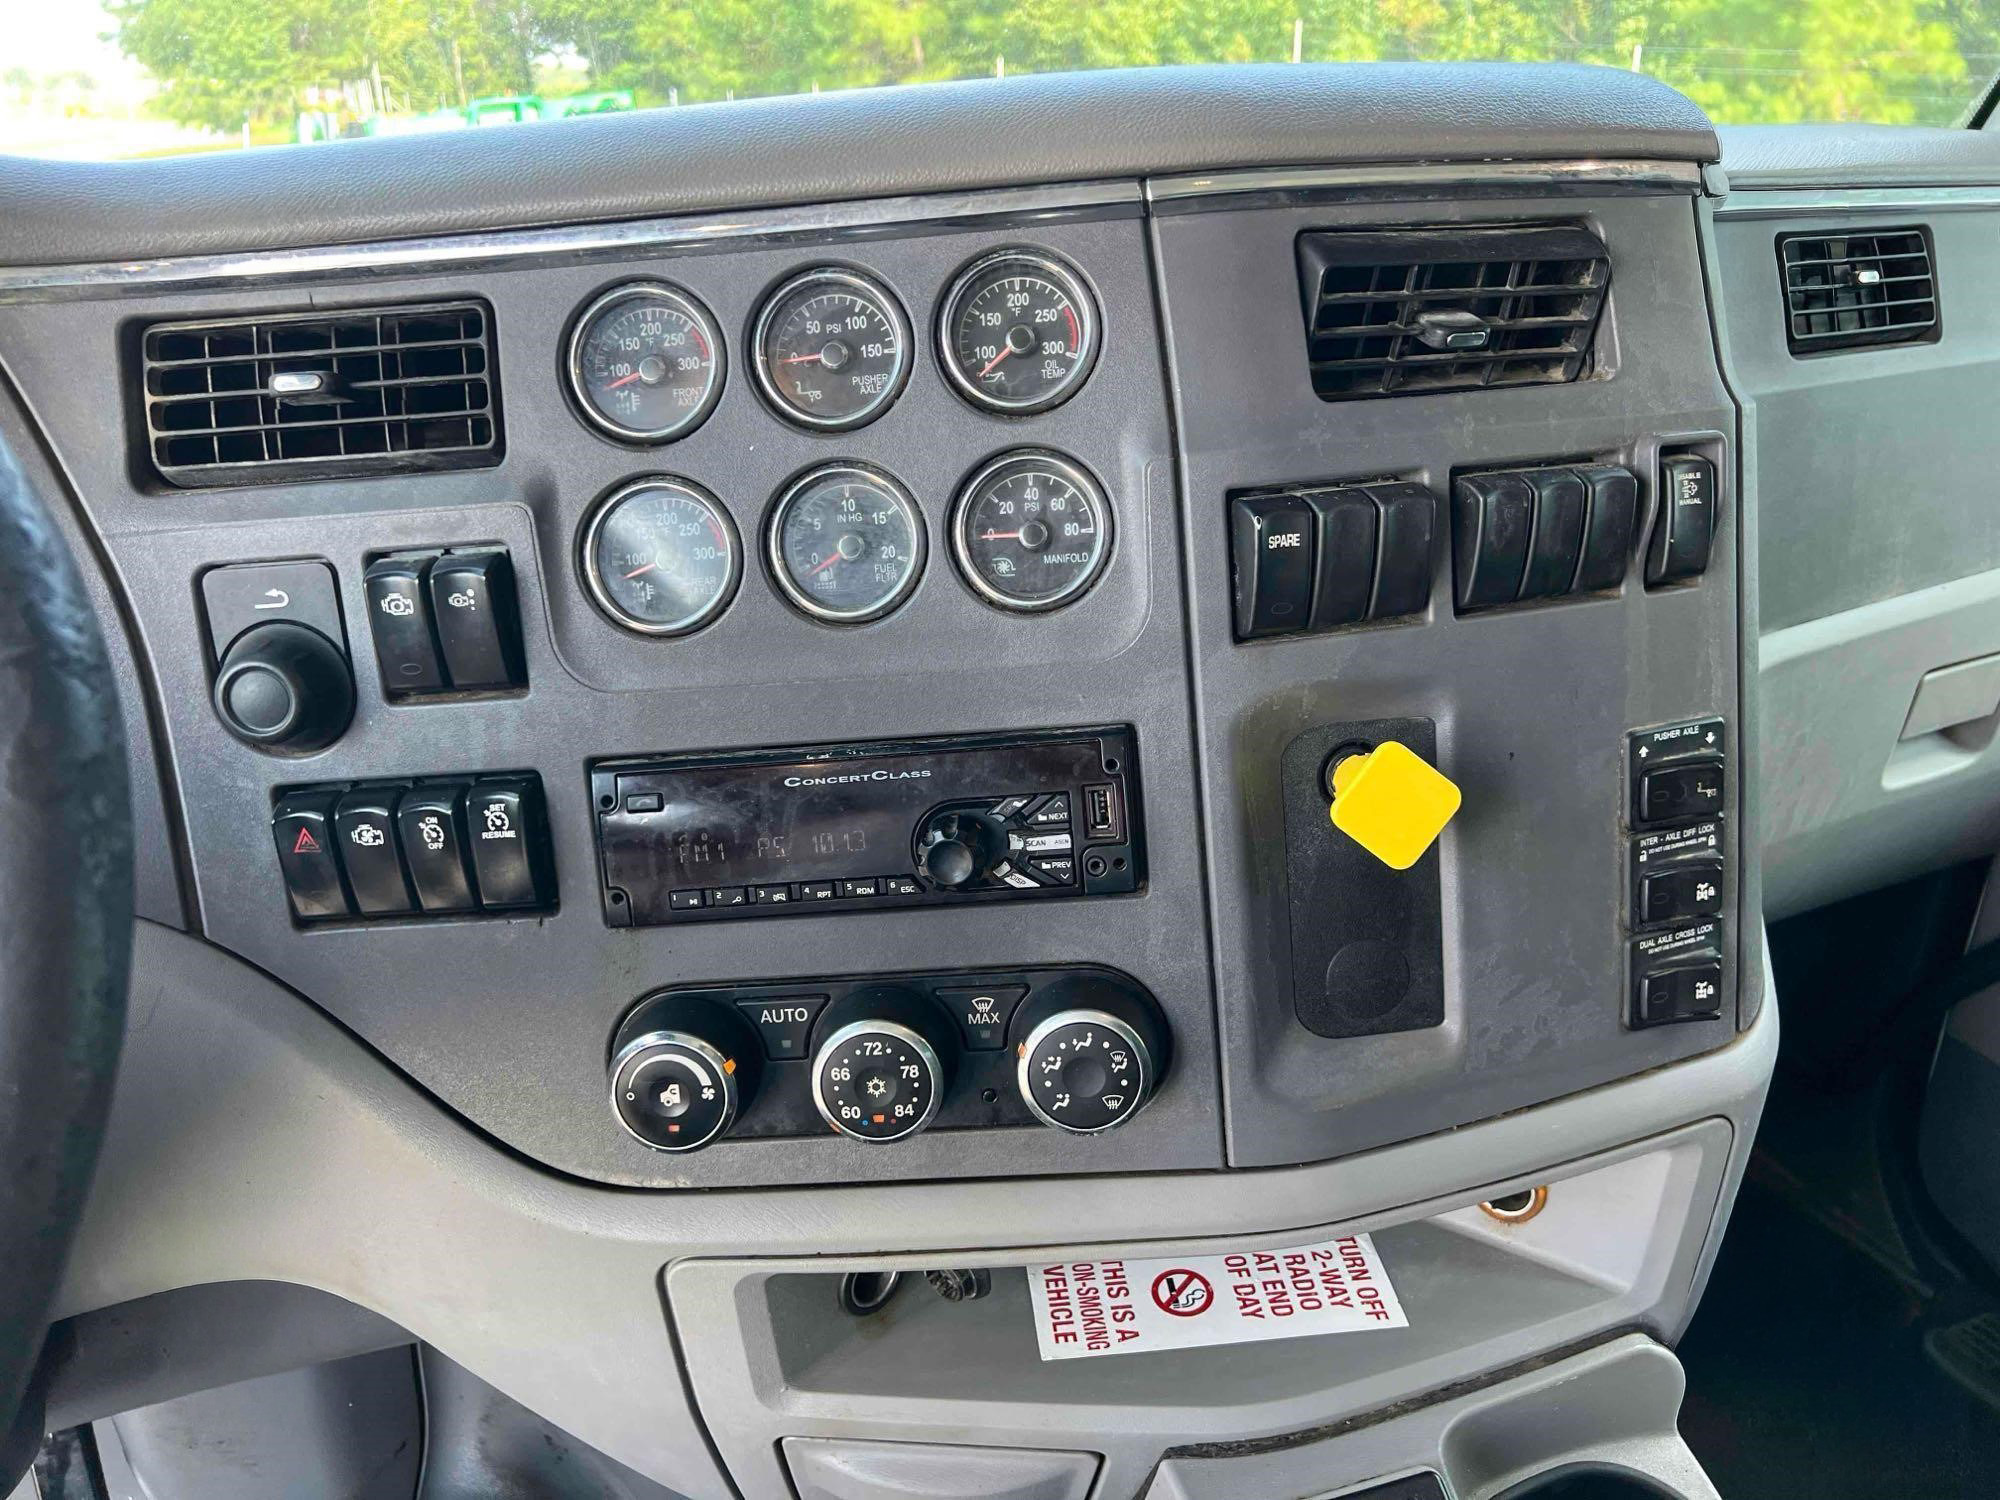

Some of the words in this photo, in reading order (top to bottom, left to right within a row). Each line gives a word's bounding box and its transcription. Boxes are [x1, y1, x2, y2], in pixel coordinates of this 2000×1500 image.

[1007, 293, 1029, 307] 200
[980, 313, 1001, 326] 150
[1035, 309, 1057, 322] 250
[640, 322, 661, 336] 200
[806, 320, 821, 334] 50
[826, 324, 841, 333] PSI
[845, 316, 867, 330] 100
[620, 337, 640, 350] 150
[663, 333, 684, 346] 250
[860, 344, 882, 358] 150
[974, 345, 996, 360] 100
[1042, 341, 1064, 354] 300
[610, 363, 630, 377] 100
[678, 357, 699, 370] 300
[1045, 360, 1058, 369] OIL
[852, 373, 889, 386] PUSHER
[1041, 369, 1066, 379] TEMP
[860, 383, 882, 395] AXLE
[1024, 488, 1038, 500] 40
[841, 499, 855, 512] 10
[999, 502, 1014, 514] 20
[1024, 502, 1040, 512] PSI
[1050, 498, 1065, 510] 60
[656, 513, 678, 526] 200
[814, 519, 821, 530] 5
[837, 514, 847, 523] IN
[849, 513, 863, 522] HG
[872, 512, 887, 525] 15
[679, 523, 700, 536] 250
[1064, 523, 1079, 536] 80
[1268, 533, 1300, 549] SPARE
[626, 553, 647, 565] 100
[694, 547, 715, 560] 300
[811, 552, 818, 564] 0
[882, 546, 895, 559] 20
[1044, 553, 1089, 564] MANIFOLD
[874, 563, 896, 572] FUEL
[876, 572, 898, 582] FLTR
[1654, 729, 1680, 741] PUSHER
[1683, 725, 1699, 736] AXLE
[489, 804, 505, 812] SET
[425, 816, 438, 824] ON
[1048, 812, 1068, 820] NEXT
[482, 830, 516, 839] RESUME
[1640, 836, 1658, 847] INTER
[1665, 831, 1681, 841] AXLE
[1683, 828, 1696, 838] DIFF
[1698, 824, 1715, 834] LOCK
[428, 842, 444, 850] OFF
[1640, 939, 1655, 949] DUAL
[1658, 934, 1672, 944] AXLE
[1675, 928, 1695, 940] CROSS
[1697, 924, 1713, 934] LOCK
[760, 1008, 808, 1024] AUTO
[968, 1012, 1000, 1025] MAX
[863, 1042, 882, 1056] 72
[831, 1068, 850, 1080] 66
[900, 1065, 919, 1079] 78
[841, 1106, 861, 1119] 60
[894, 1105, 914, 1116] 84
[1225, 1256, 1251, 1277] OF
[1252, 1253, 1280, 1273] AT
[1100, 1260, 1130, 1299] THIS
[1283, 1254, 1323, 1310] RADIO
[1311, 1250, 1354, 1308] 2-WAY
[1335, 1236, 1372, 1282] TURN
[1356, 1287, 1389, 1321] OFF
[1043, 1264, 1078, 1344] VEHICLE
[1233, 1284, 1265, 1319] DAY
[1262, 1280, 1294, 1317] END
[1111, 1304, 1135, 1323] IS
[1116, 1329, 1140, 1343] A
